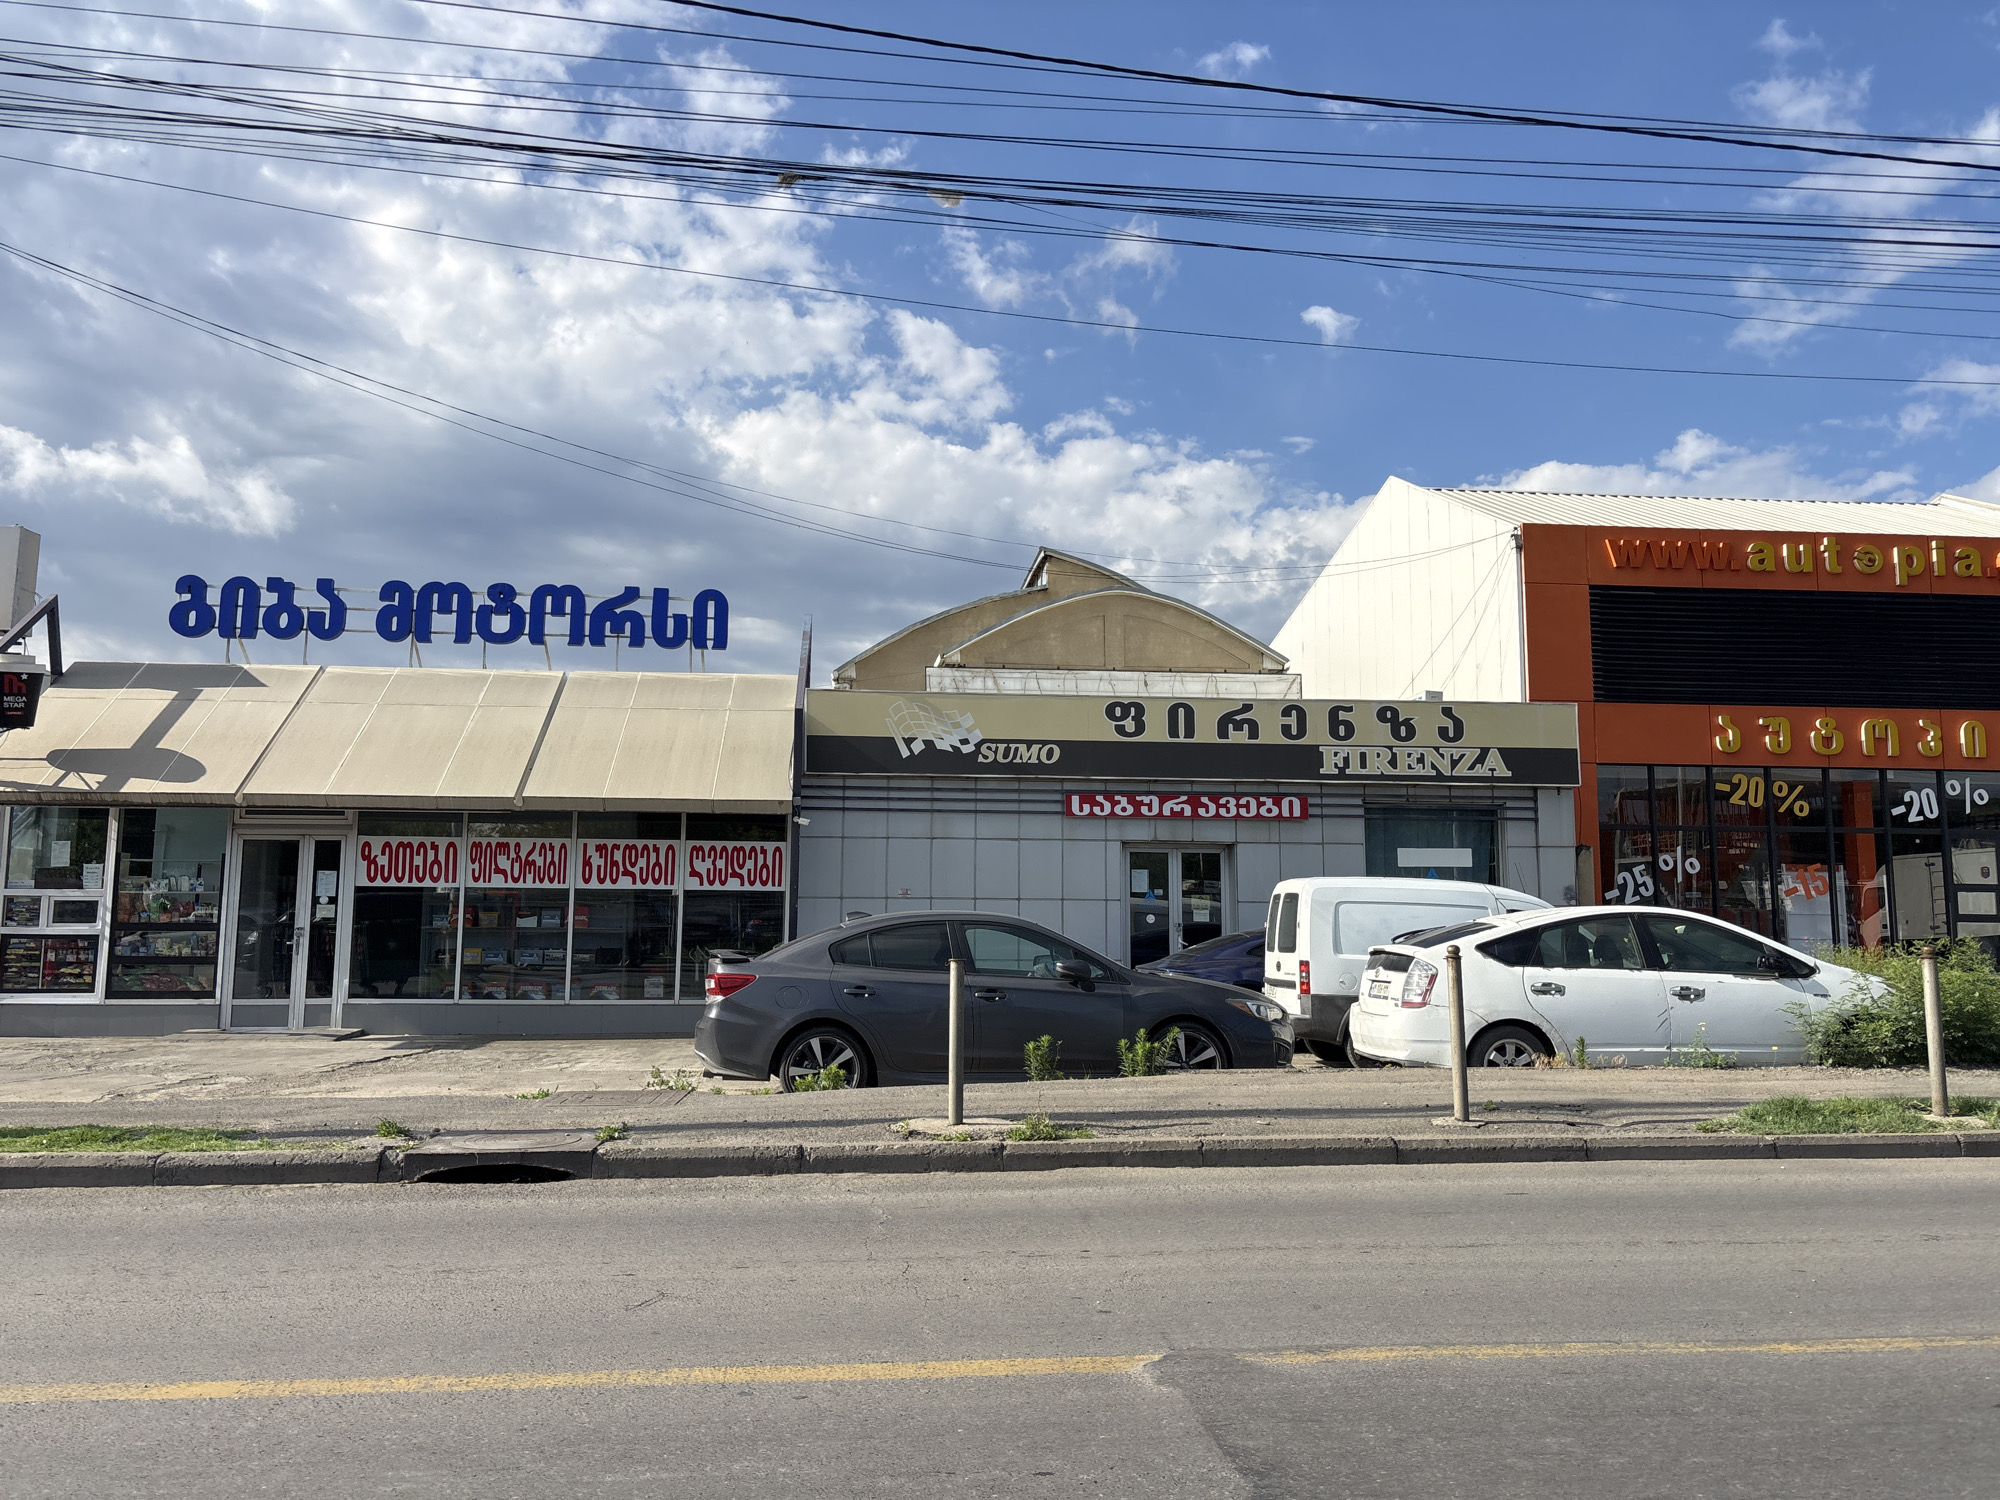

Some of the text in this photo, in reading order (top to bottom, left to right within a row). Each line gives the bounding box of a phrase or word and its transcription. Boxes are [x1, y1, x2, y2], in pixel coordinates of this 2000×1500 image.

[1605, 537, 2000, 586] www.autopia.
[169, 574, 729, 651] გიბა მოტორსი
[1104, 700, 1466, 744] ფირენზა
[977, 742, 1061, 764] SUMO
[1319, 746, 1512, 777] FIRENZA
[1071, 795, 1301, 818] საბურავები
[360, 841, 457, 884] ზეთები
[469, 841, 568, 885] ფილტრები
[581, 842, 676, 886] ხუნდები
[688, 844, 783, 888] ღვედები
[1783, 862, 1830, 901] -15
